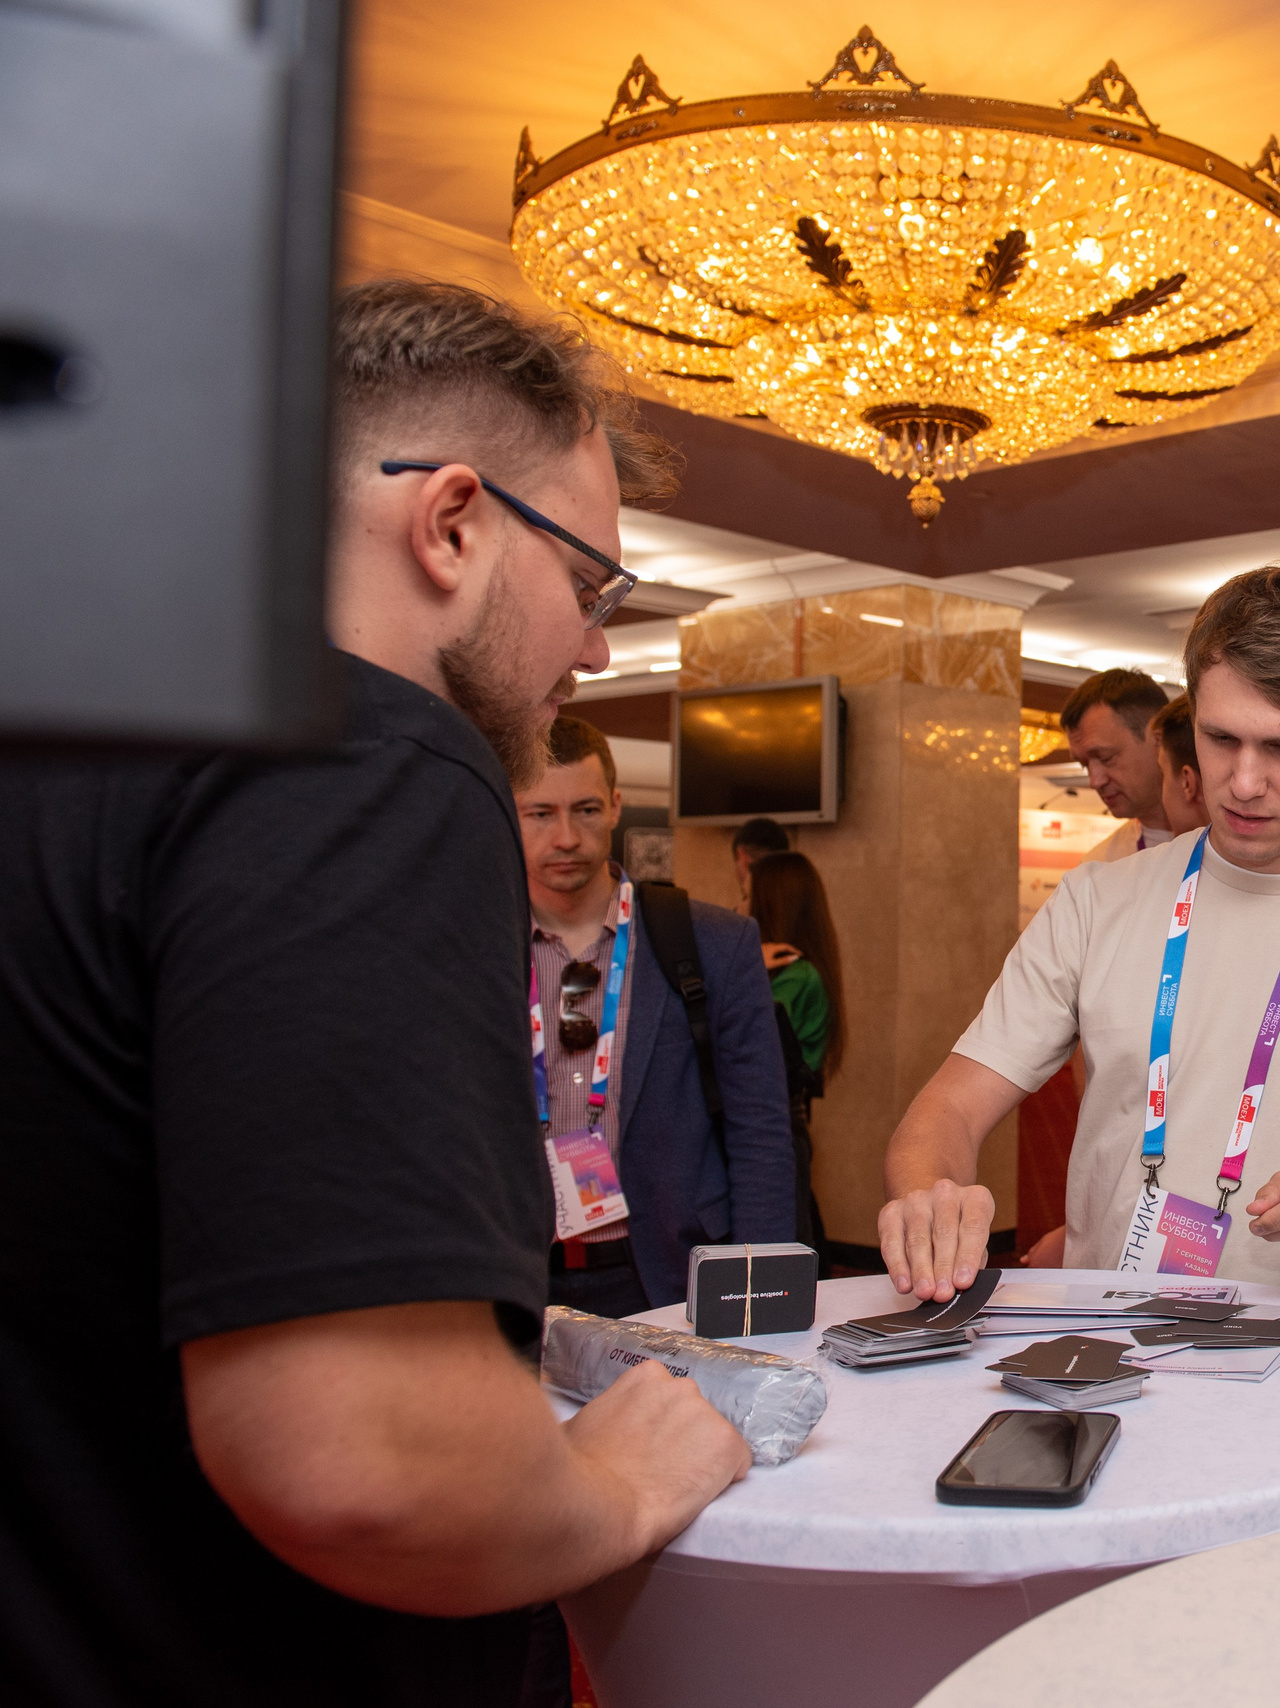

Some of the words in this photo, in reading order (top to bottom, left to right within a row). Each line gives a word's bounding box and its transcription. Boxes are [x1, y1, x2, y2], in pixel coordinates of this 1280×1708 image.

[1180, 904, 1190, 925] MOEX
[1158, 985, 1170, 1016] ИНВЕСТ
[1166, 982, 1179, 1017] СУББОТА
[1260, 1002, 1276, 1036] СУББОТА
[1155, 1092, 1164, 1116] MOEX
[1239, 1096, 1251, 1120] MOEX
[1163, 1210, 1208, 1233] ИНВЕСТ
[1120, 1195, 1159, 1272] СТНИК
[1160, 1221, 1207, 1246] СУББОТА
[1180, 1249, 1213, 1267] СЕНТЯБРЯ
[1184, 1262, 1210, 1275] КАЗАНЬ
[720, 1293, 759, 1301] tecnologies
[759, 1290, 784, 1298] positive
[1102, 1290, 1228, 1300] POSI
[609, 1348, 624, 1362] ОТ
